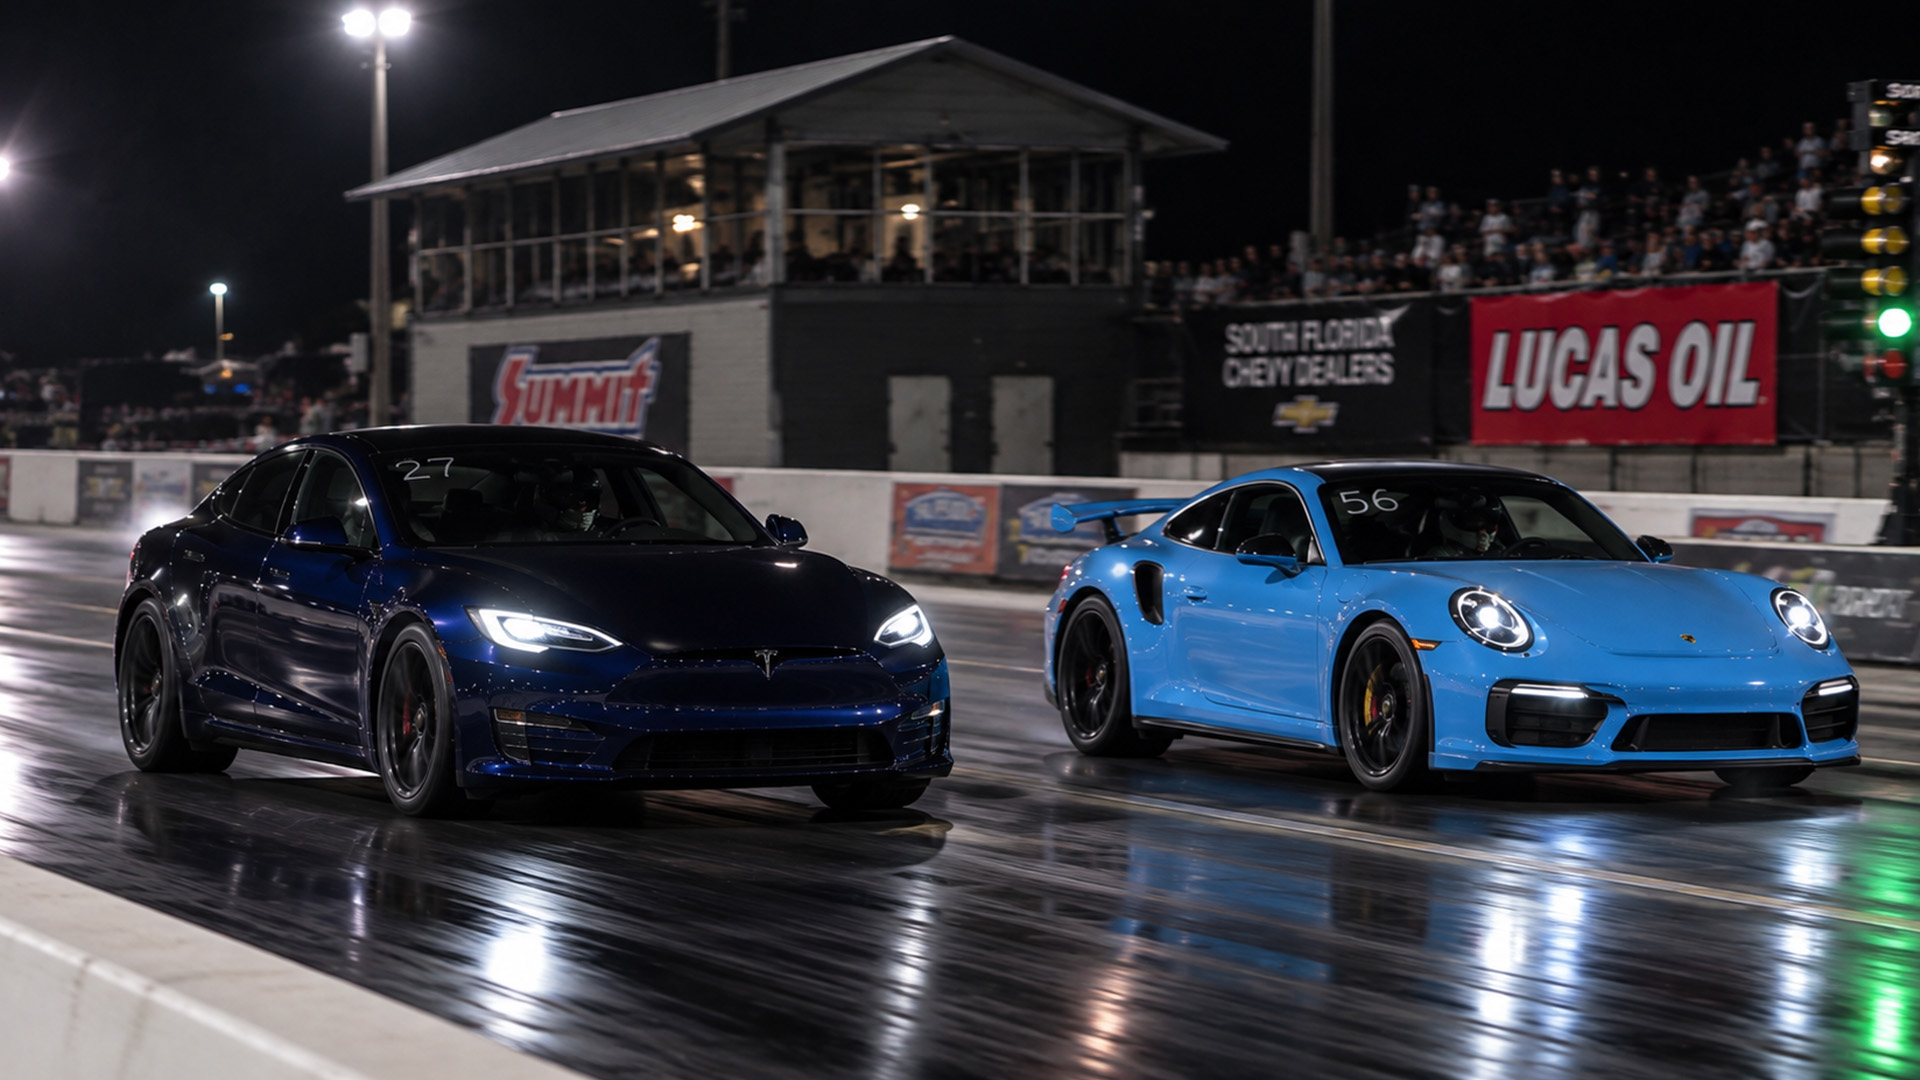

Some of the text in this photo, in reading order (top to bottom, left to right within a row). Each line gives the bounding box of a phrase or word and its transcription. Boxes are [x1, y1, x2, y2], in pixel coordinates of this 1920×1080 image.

[1225, 317, 1395, 353] SOUTH FLORIDA
[1222, 352, 1395, 388] CHEVY DEALERS
[1482, 319, 1761, 411] LUCAS OIL
[396, 457, 454, 480] 27
[1340, 489, 1399, 514] 56
